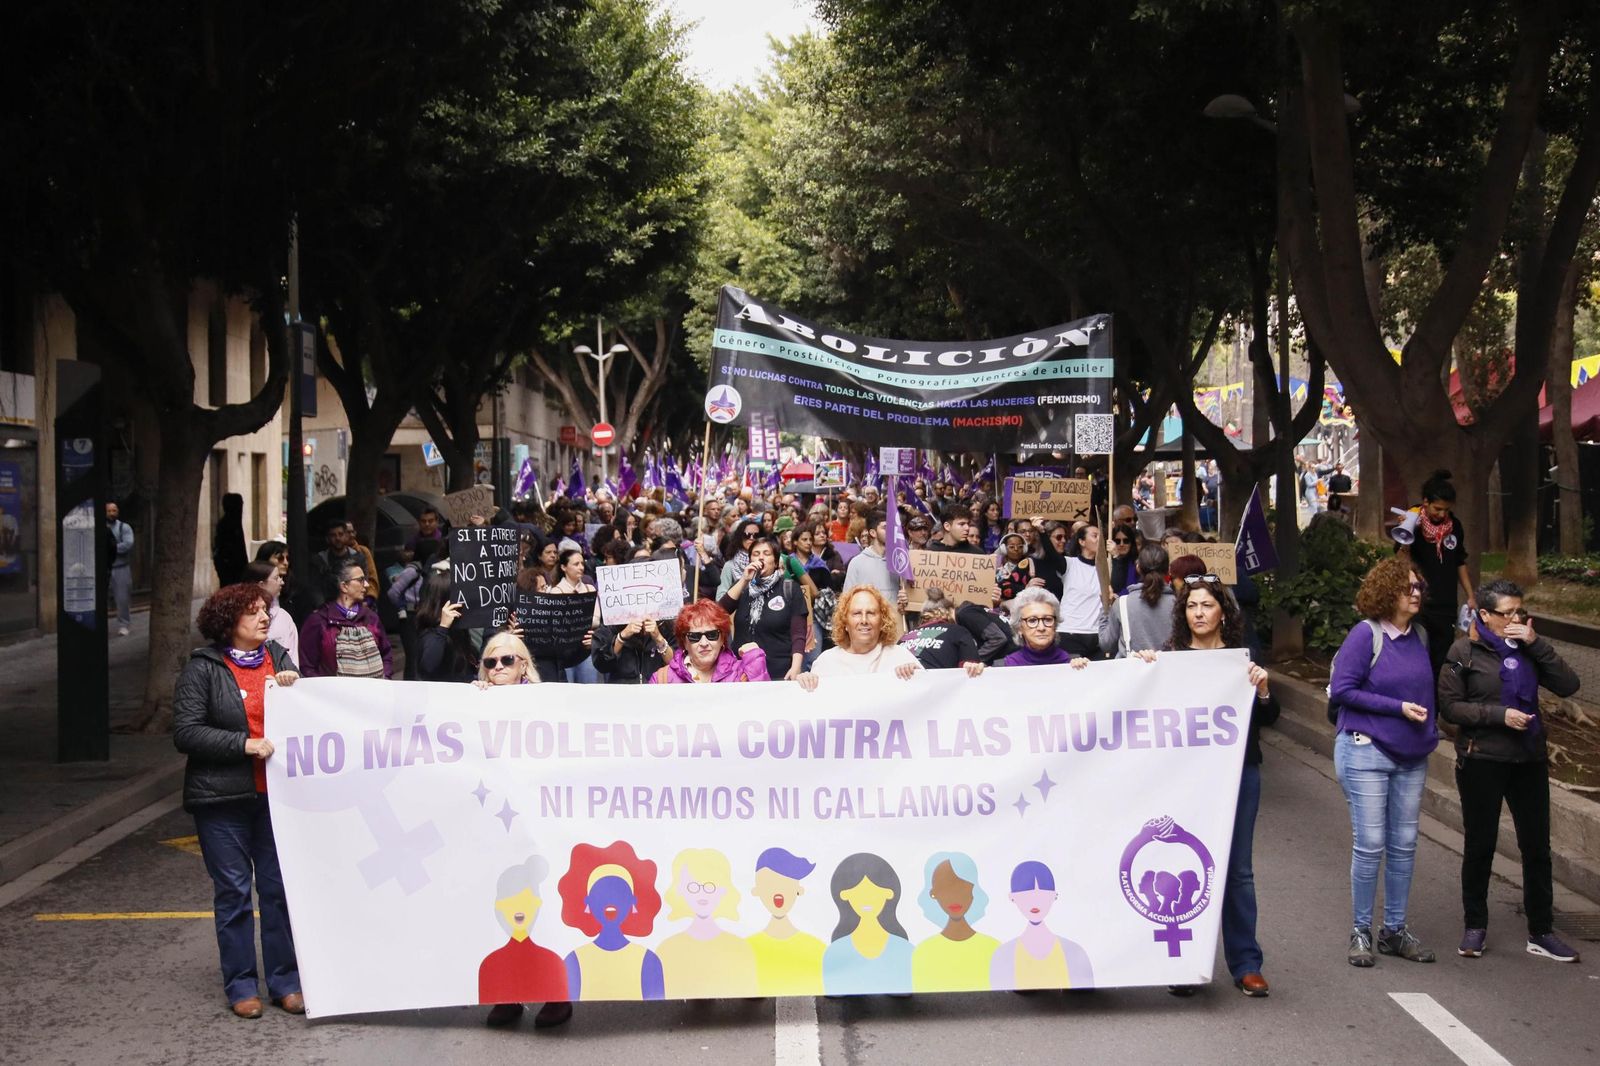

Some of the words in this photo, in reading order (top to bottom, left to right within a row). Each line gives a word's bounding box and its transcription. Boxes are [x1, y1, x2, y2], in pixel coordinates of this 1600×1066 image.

[719, 334, 766, 350] Género
[779, 344, 861, 374] Prostitución
[877, 372, 960, 389] Pornografía
[972, 367, 1027, 384] Vientres
[1032, 366, 1047, 376] de
[1052, 362, 1105, 376] alquiler
[720, 365, 733, 374] SI
[734, 367, 747, 377] NO
[748, 369, 786, 383] LUCHAS
[788, 376, 823, 391] CONTRA
[824, 384, 855, 397] TODAS
[856, 390, 879, 402] LAS
[876, 393, 935, 409] VIOLENCIAS
[936, 400, 968, 409] HACIA
[970, 399, 989, 408] LAS
[990, 396, 1035, 407] MUJERES
[1037, 394, 1101, 405] (FEMINISMO)
[793, 394, 822, 409] ERES
[824, 400, 860, 416] PARTE
[863, 408, 884, 421] DEL
[887, 412, 949, 426] PROBLEMA
[952, 415, 1023, 428] (MACHISMO)
[1053, 442, 1067, 450] aquí
[1014, 480, 1043, 494] LEY
[1050, 481, 1089, 494] TRANS
[457, 529, 471, 541] SI
[475, 529, 487, 541] TE
[480, 545, 488, 558] A
[1174, 545, 1189, 555] SIN
[945, 555, 967, 568] NO
[972, 558, 995, 570] ERA
[454, 562, 477, 583] NO
[480, 561, 495, 579] TE
[913, 568, 938, 577] UNA
[941, 569, 977, 581] ZORRA
[604, 584, 619, 592] AL
[968, 585, 988, 594] ERAS
[456, 590, 469, 609] A
[519, 594, 532, 604] EL
[286, 731, 345, 778] NO
[363, 713, 464, 770] MÁS
[479, 719, 722, 759] VIOLENCIA
[737, 718, 913, 760] CONTRA
[927, 716, 1012, 758] LAS
[1028, 704, 1239, 754] MUJERES
[541, 785, 573, 819] NI
[588, 785, 754, 820] PARAMOS
[768, 786, 800, 820] NI
[813, 782, 996, 820] CALLAMOS
[1120, 870, 1148, 915] PLATAFORMA
[1148, 911, 1175, 923] ACCIÓN
[1175, 899, 1208, 923] FEMINISTA
